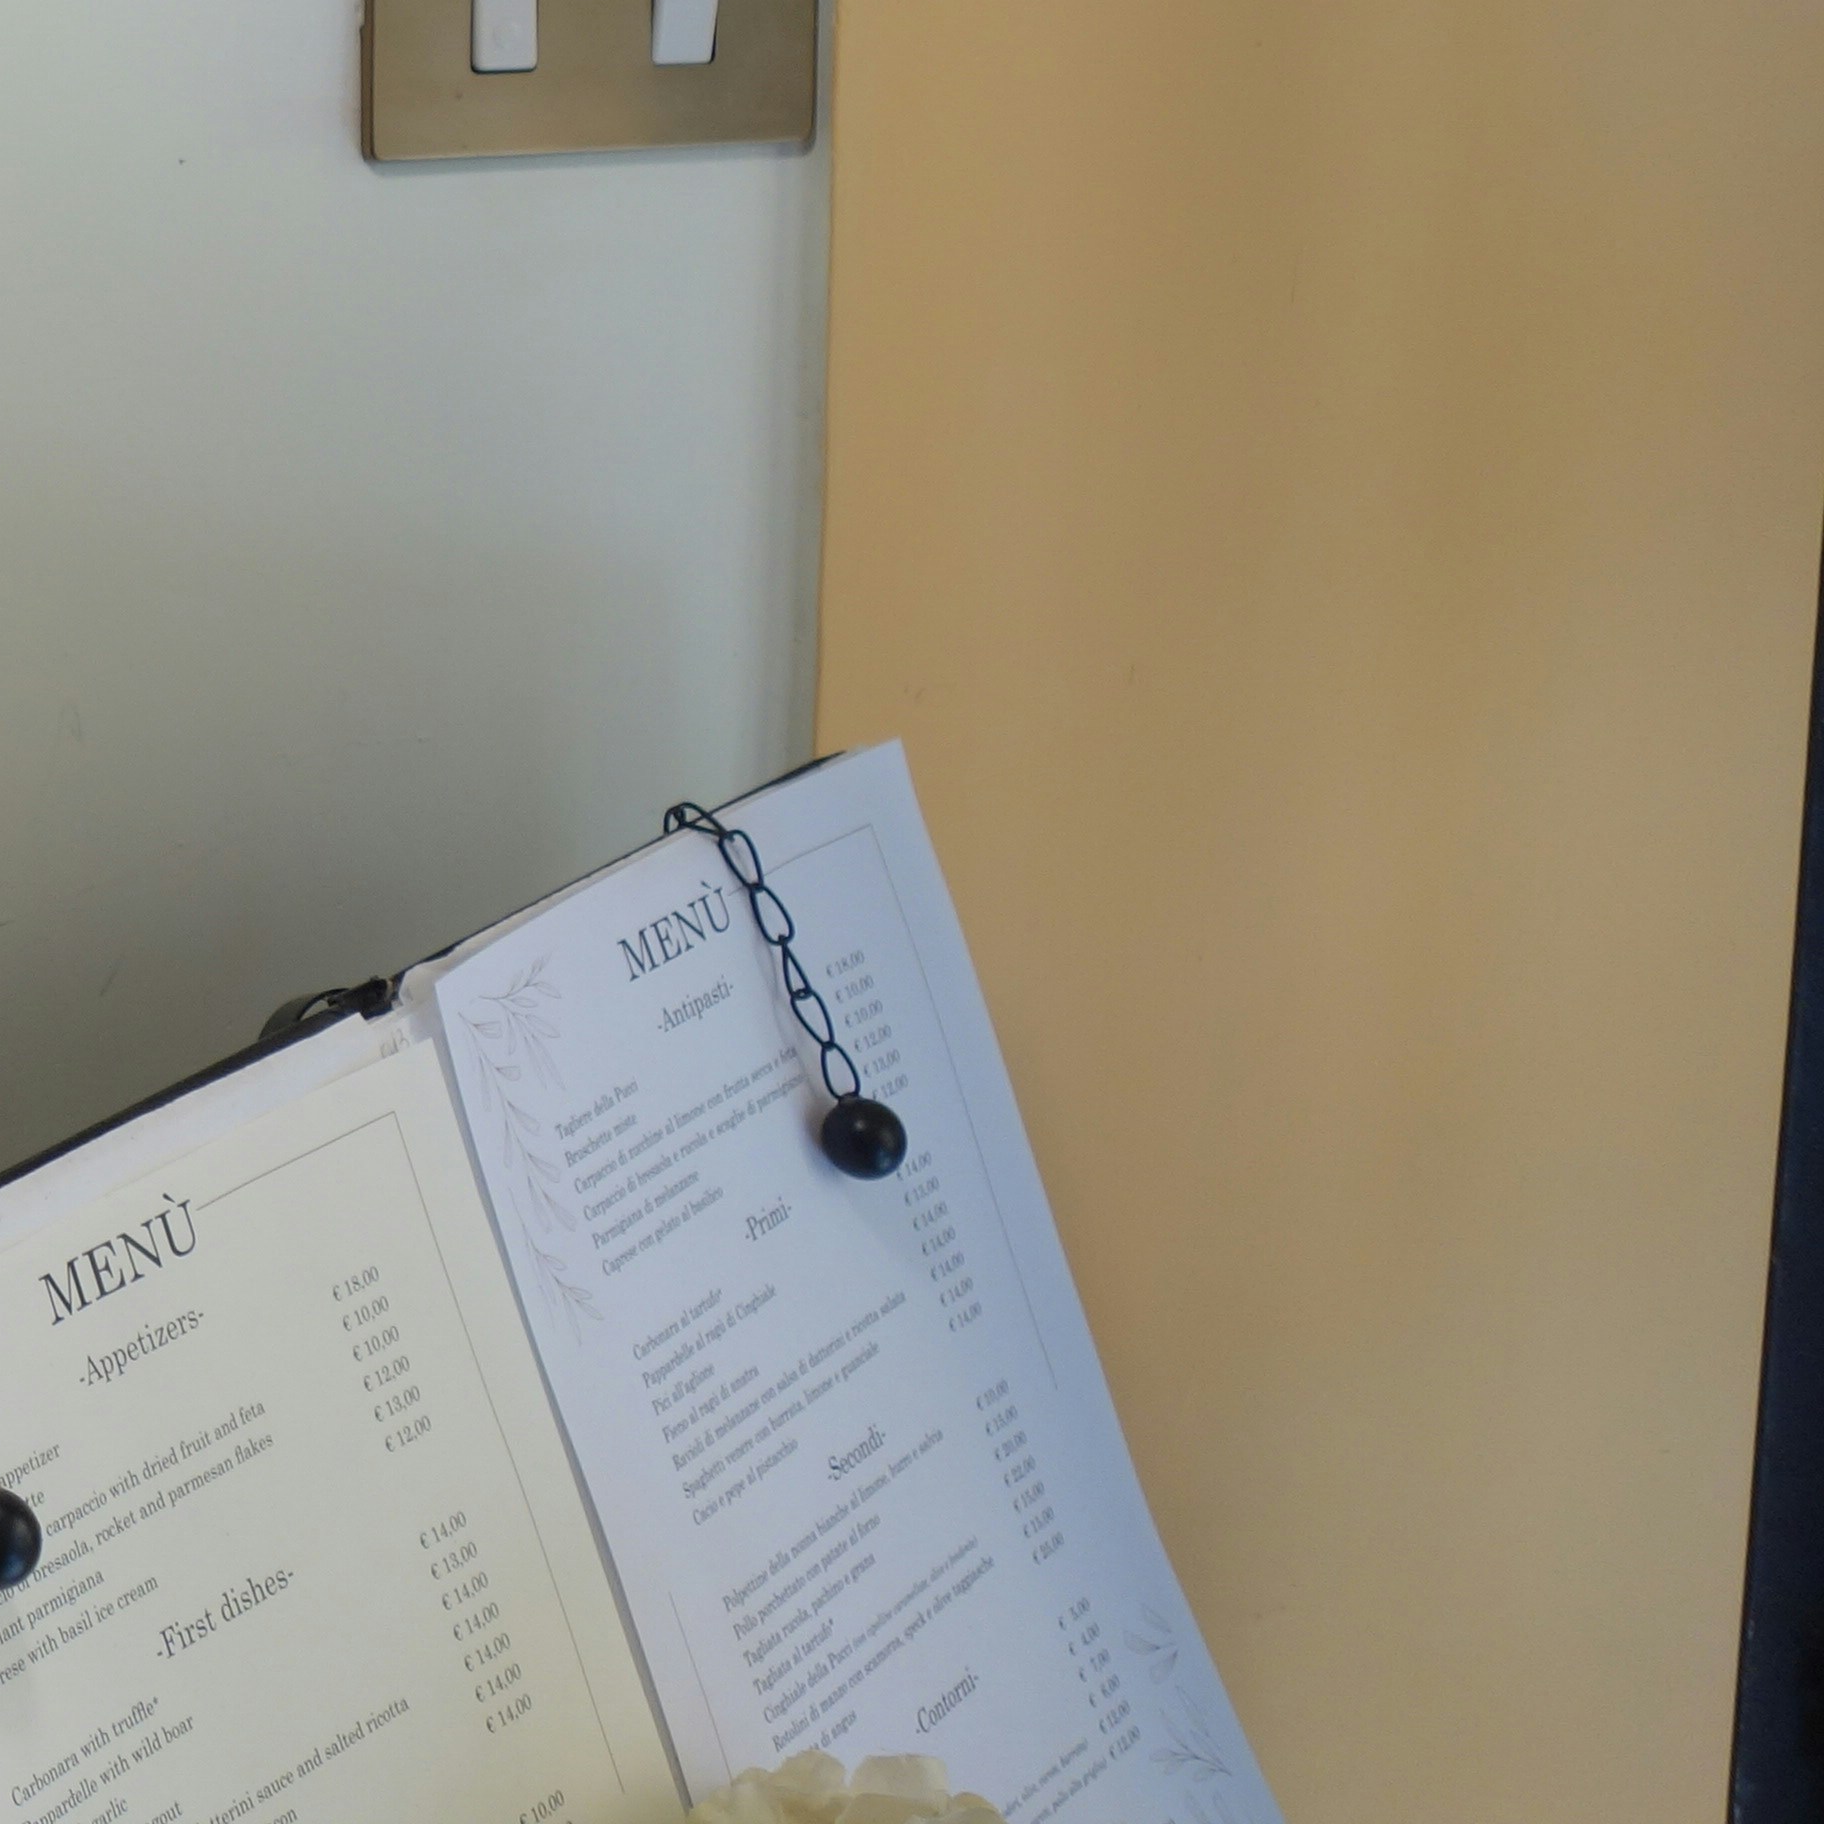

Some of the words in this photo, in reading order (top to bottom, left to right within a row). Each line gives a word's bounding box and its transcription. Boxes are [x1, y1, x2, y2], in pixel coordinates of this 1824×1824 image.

[616, 880, 730, 982] MENÙ
[573, 1159, 618, 1195] Carpaccio
[582, 1184, 627, 1222] Carpaccio
[38, 1192, 196, 1326] MENÙ
[637, 1233, 656, 1253] con
[344, 1265, 380, 1297] 18,00
[353, 1295, 390, 1326] 10,00
[363, 1325, 400, 1357] 10,00
[632, 1321, 681, 1361] Carbonara
[374, 1355, 411, 1387] 12,00
[384, 1385, 421, 1417] 13,00
[396, 1414, 432, 1447] 12,00
[45, 1490, 108, 1538] carpaccio
[108, 1469, 142, 1499] with
[142, 1446, 180, 1481] dried
[179, 1431, 212, 1460] fruit
[213, 1411, 240, 1441] and
[238, 1402, 266, 1426] feta
[94, 1510, 138, 1546] rocket
[138, 1490, 167, 1520] and
[167, 1457, 234, 1508] parmesan
[234, 1434, 274, 1465] flakes
[430, 1510, 467, 1543] 14,00
[441, 1540, 478, 1574] 13,00
[26, 1570, 105, 1631] parmigiana
[453, 1571, 489, 1605] 14,00
[26, 1634, 60, 1664] with
[56, 1609, 94, 1644] basil
[93, 1602, 115, 1624] ice
[116, 1576, 159, 1610] cream
[464, 1601, 500, 1635] 14,00
[475, 1632, 511, 1666] 14,00
[486, 1662, 522, 1697] 14,00
[497, 1693, 532, 1727] 14,00
[11, 1752, 80, 1807] Carbonara
[79, 1727, 111, 1758] with
[99, 1754, 131, 1785] with
[130, 1731, 163, 1764] wild
[160, 1715, 194, 1744] boar
[256, 1771, 294, 1804] sauce
[296, 1747, 324, 1779] and
[324, 1720, 366, 1761] salted
[365, 1698, 410, 1734] ricotta
[531, 1789, 565, 1823] 10,00
